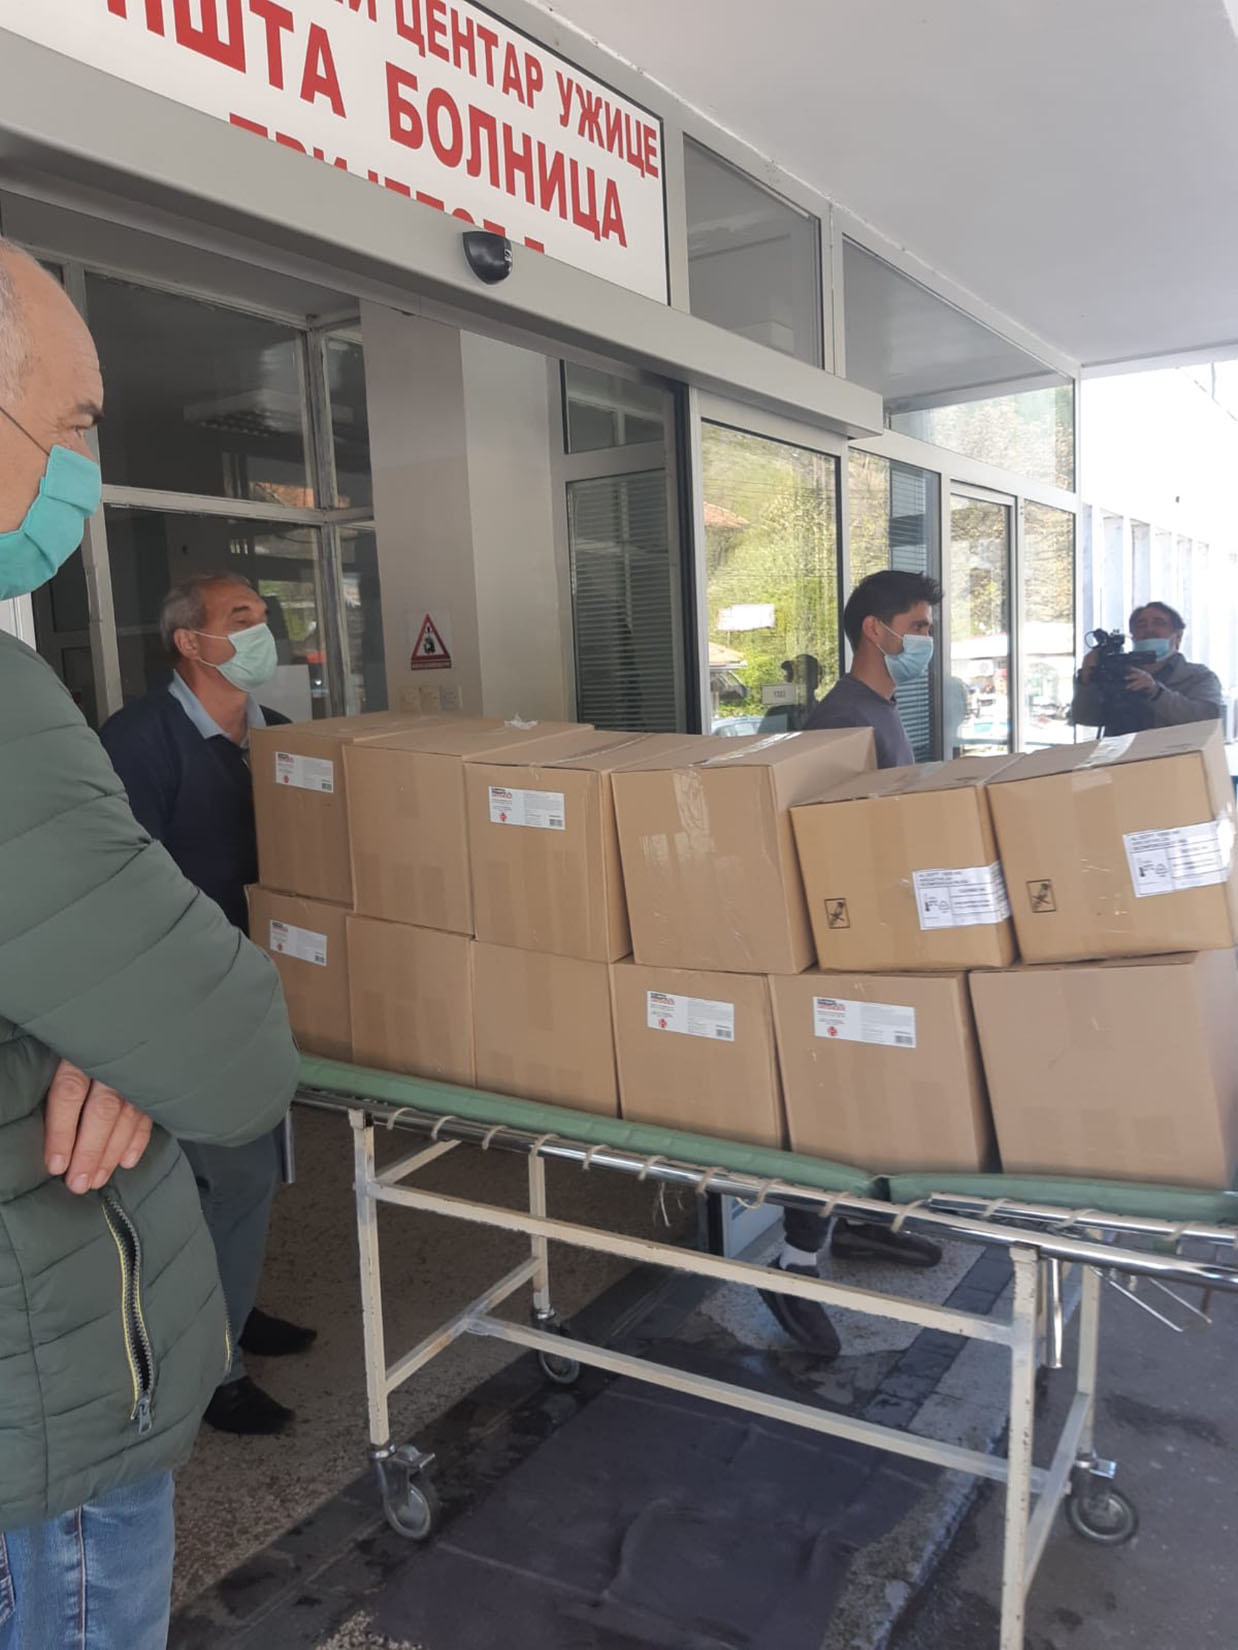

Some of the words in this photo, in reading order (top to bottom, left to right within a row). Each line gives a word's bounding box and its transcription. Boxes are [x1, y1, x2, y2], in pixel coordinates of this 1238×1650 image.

[385, 62, 628, 249] БОЛНИЦА
[395, 0, 543, 108] ЦЕНТАР
[556, 72, 660, 179] УЖИЦЕ
